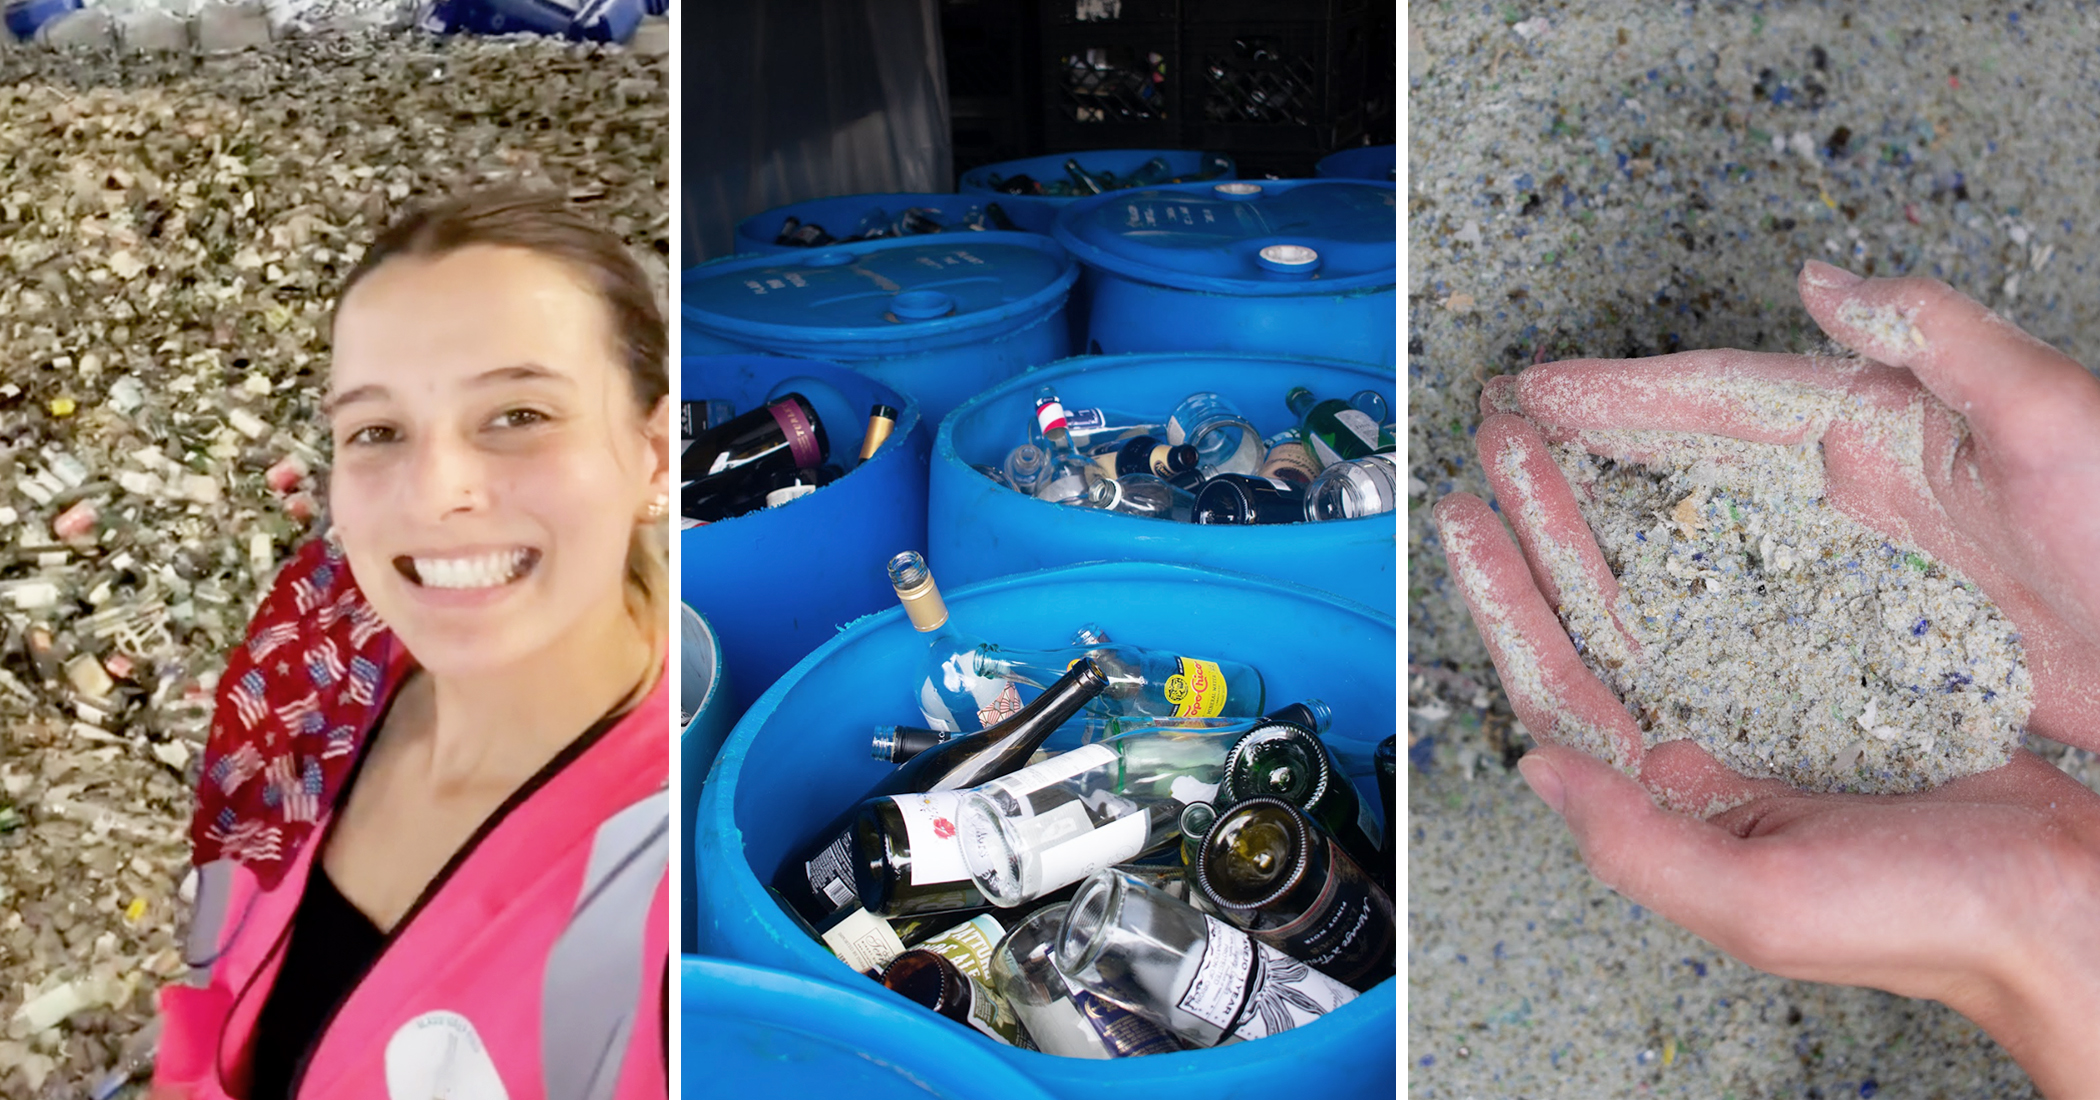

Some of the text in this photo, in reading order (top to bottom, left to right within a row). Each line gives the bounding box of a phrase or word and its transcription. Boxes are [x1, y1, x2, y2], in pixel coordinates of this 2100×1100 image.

[1191, 661, 1209, 693] Chico
[1206, 691, 1216, 714] MINERAL
[1327, 900, 1348, 929] PINOT
[865, 934, 887, 962] Terr
[1303, 928, 1328, 945] NOIR
[1212, 943, 1229, 986] PROTECTED
[1194, 979, 1211, 1005] ORIGIN
[1221, 984, 1242, 1016] YEAR
